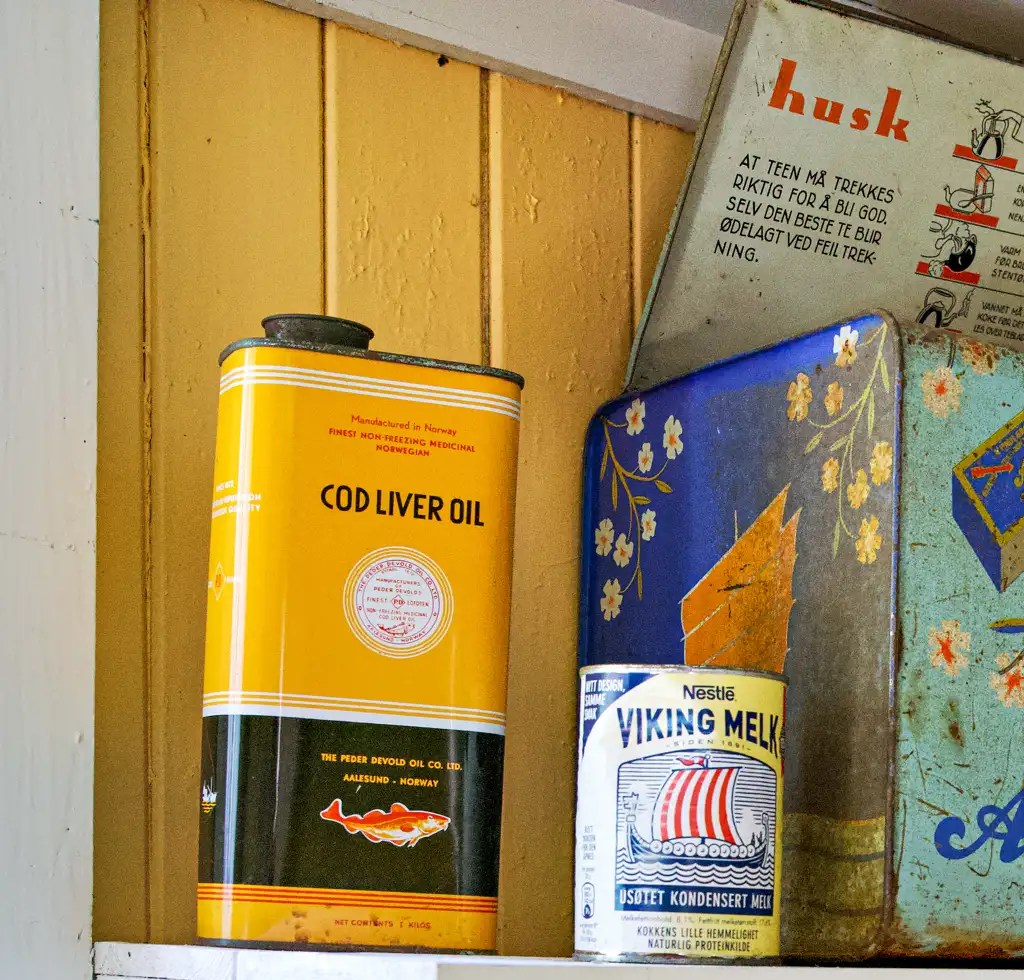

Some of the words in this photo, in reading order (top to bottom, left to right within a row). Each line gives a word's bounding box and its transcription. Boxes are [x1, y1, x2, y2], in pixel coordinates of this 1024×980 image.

[767, 57, 910, 142] husk
[740, 154, 760, 171] AT
[768, 159, 801, 182] TEEN
[805, 170, 827, 188] MÅ
[834, 176, 895, 204] TREKKES
[733, 173, 783, 200] RIKTIG
[789, 188, 816, 208] FOR
[819, 194, 830, 211] Å
[834, 199, 854, 217] BLI
[859, 205, 888, 225] GOD.
[726, 196, 760, 215] SELV
[764, 204, 792, 224] DEN
[797, 212, 834, 235] BESTE
[837, 221, 852, 236] TE
[713, 239, 760, 262] NING.
[720, 217, 784, 244] ØDELAGT
[787, 231, 812, 251] VED
[814, 238, 839, 257] FEIL
[843, 246, 877, 264] TREK-
[351, 414, 411, 430] Manufactured
[413, 422, 422, 432] in
[424, 422, 458, 437] Norway
[329, 427, 357, 439] FINEST
[360, 431, 427, 447] NON-FREEZING
[429, 440, 476, 453] MEDICINAL
[375, 444, 430, 457] NORWEGIAN
[320, 483, 370, 512] COD
[376, 489, 444, 522] LIVER
[449, 497, 485, 527] OIL
[616, 707, 717, 749] VIKING
[724, 710, 780, 759] MELK
[673, 739, 714, 748] SIDEN
[321, 753, 337, 762] THE
[340, 754, 368, 764] PEDER
[370, 756, 406, 766] DEVOLD
[409, 759, 424, 768] OIL
[427, 761, 443, 769] CO.
[446, 761, 463, 770] LTD.
[343, 773, 389, 785] AALESUND
[399, 777, 439, 788] NORWAY
[619, 889, 665, 905] USØTET
[670, 890, 748, 909] KONDENSERT
[751, 894, 771, 909] MELK
[637, 926, 677, 938] KOKKENS
[681, 928, 703, 938] LILLE
[706, 929, 759, 940] HEMMELIGHET
[648, 939, 691, 950] NATURLIG
[695, 941, 751, 952] PROTEINKILDE
